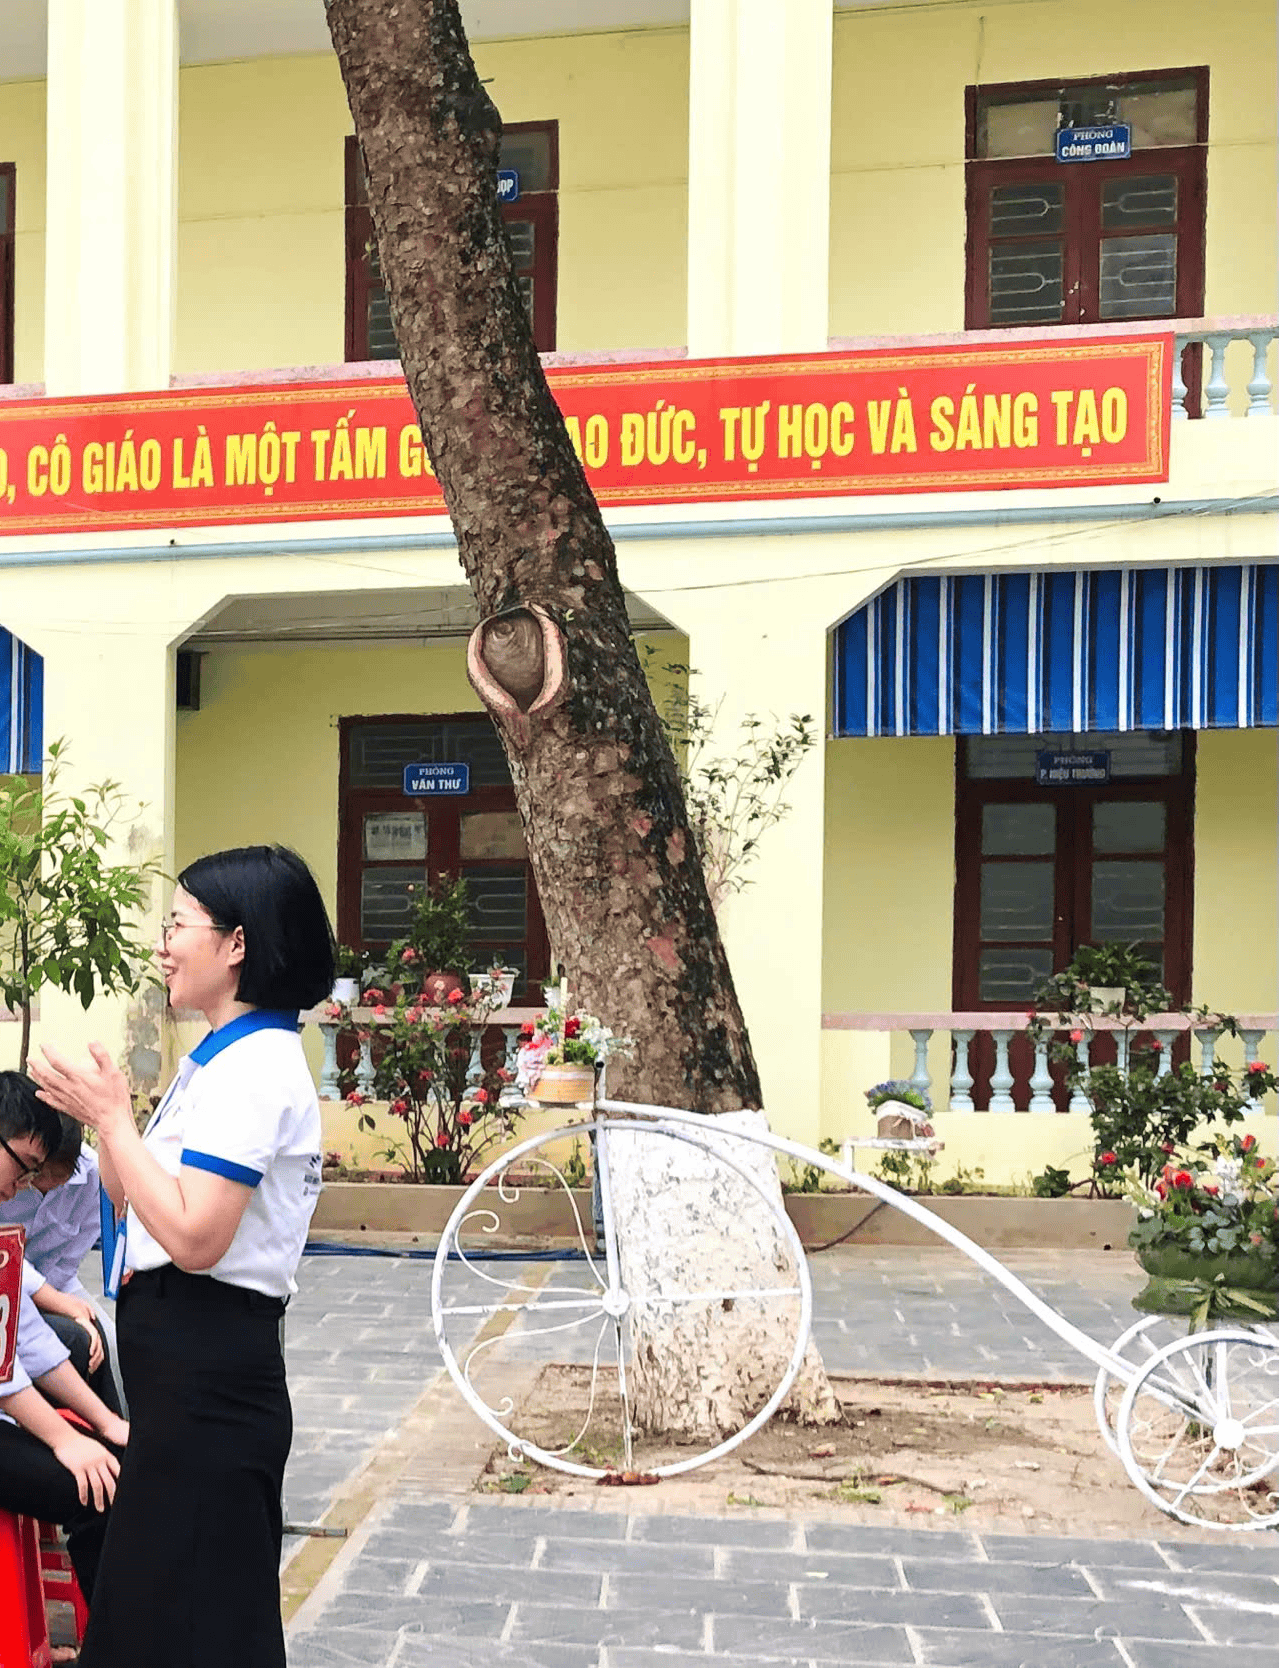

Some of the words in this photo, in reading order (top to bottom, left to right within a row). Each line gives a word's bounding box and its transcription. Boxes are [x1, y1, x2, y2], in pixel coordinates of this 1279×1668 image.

[1073, 129, 1113, 141] PHÒNG
[1061, 144, 1092, 157] CÔNG
[1094, 141, 1125, 154] ĐOÀN
[497, 179, 514, 196] ỌP
[620, 399, 707, 470] ĐỨC,
[720, 399, 770, 472] TỰ
[778, 402, 855, 470] HỌC
[868, 386, 918, 453] VÀ
[930, 383, 1038, 451] SÁNG
[1051, 387, 1128, 458] TẠO
[27, 433, 71, 496] CÔ
[82, 429, 161, 494] GIÁO
[173, 425, 213, 489] LÀ
[225, 421, 301, 496] MỘT
[311, 410, 387, 481] TẤM
[419, 766, 454, 776] PHÒNG
[412, 778, 435, 790] VĂN
[438, 778, 461, 790] THƯ
